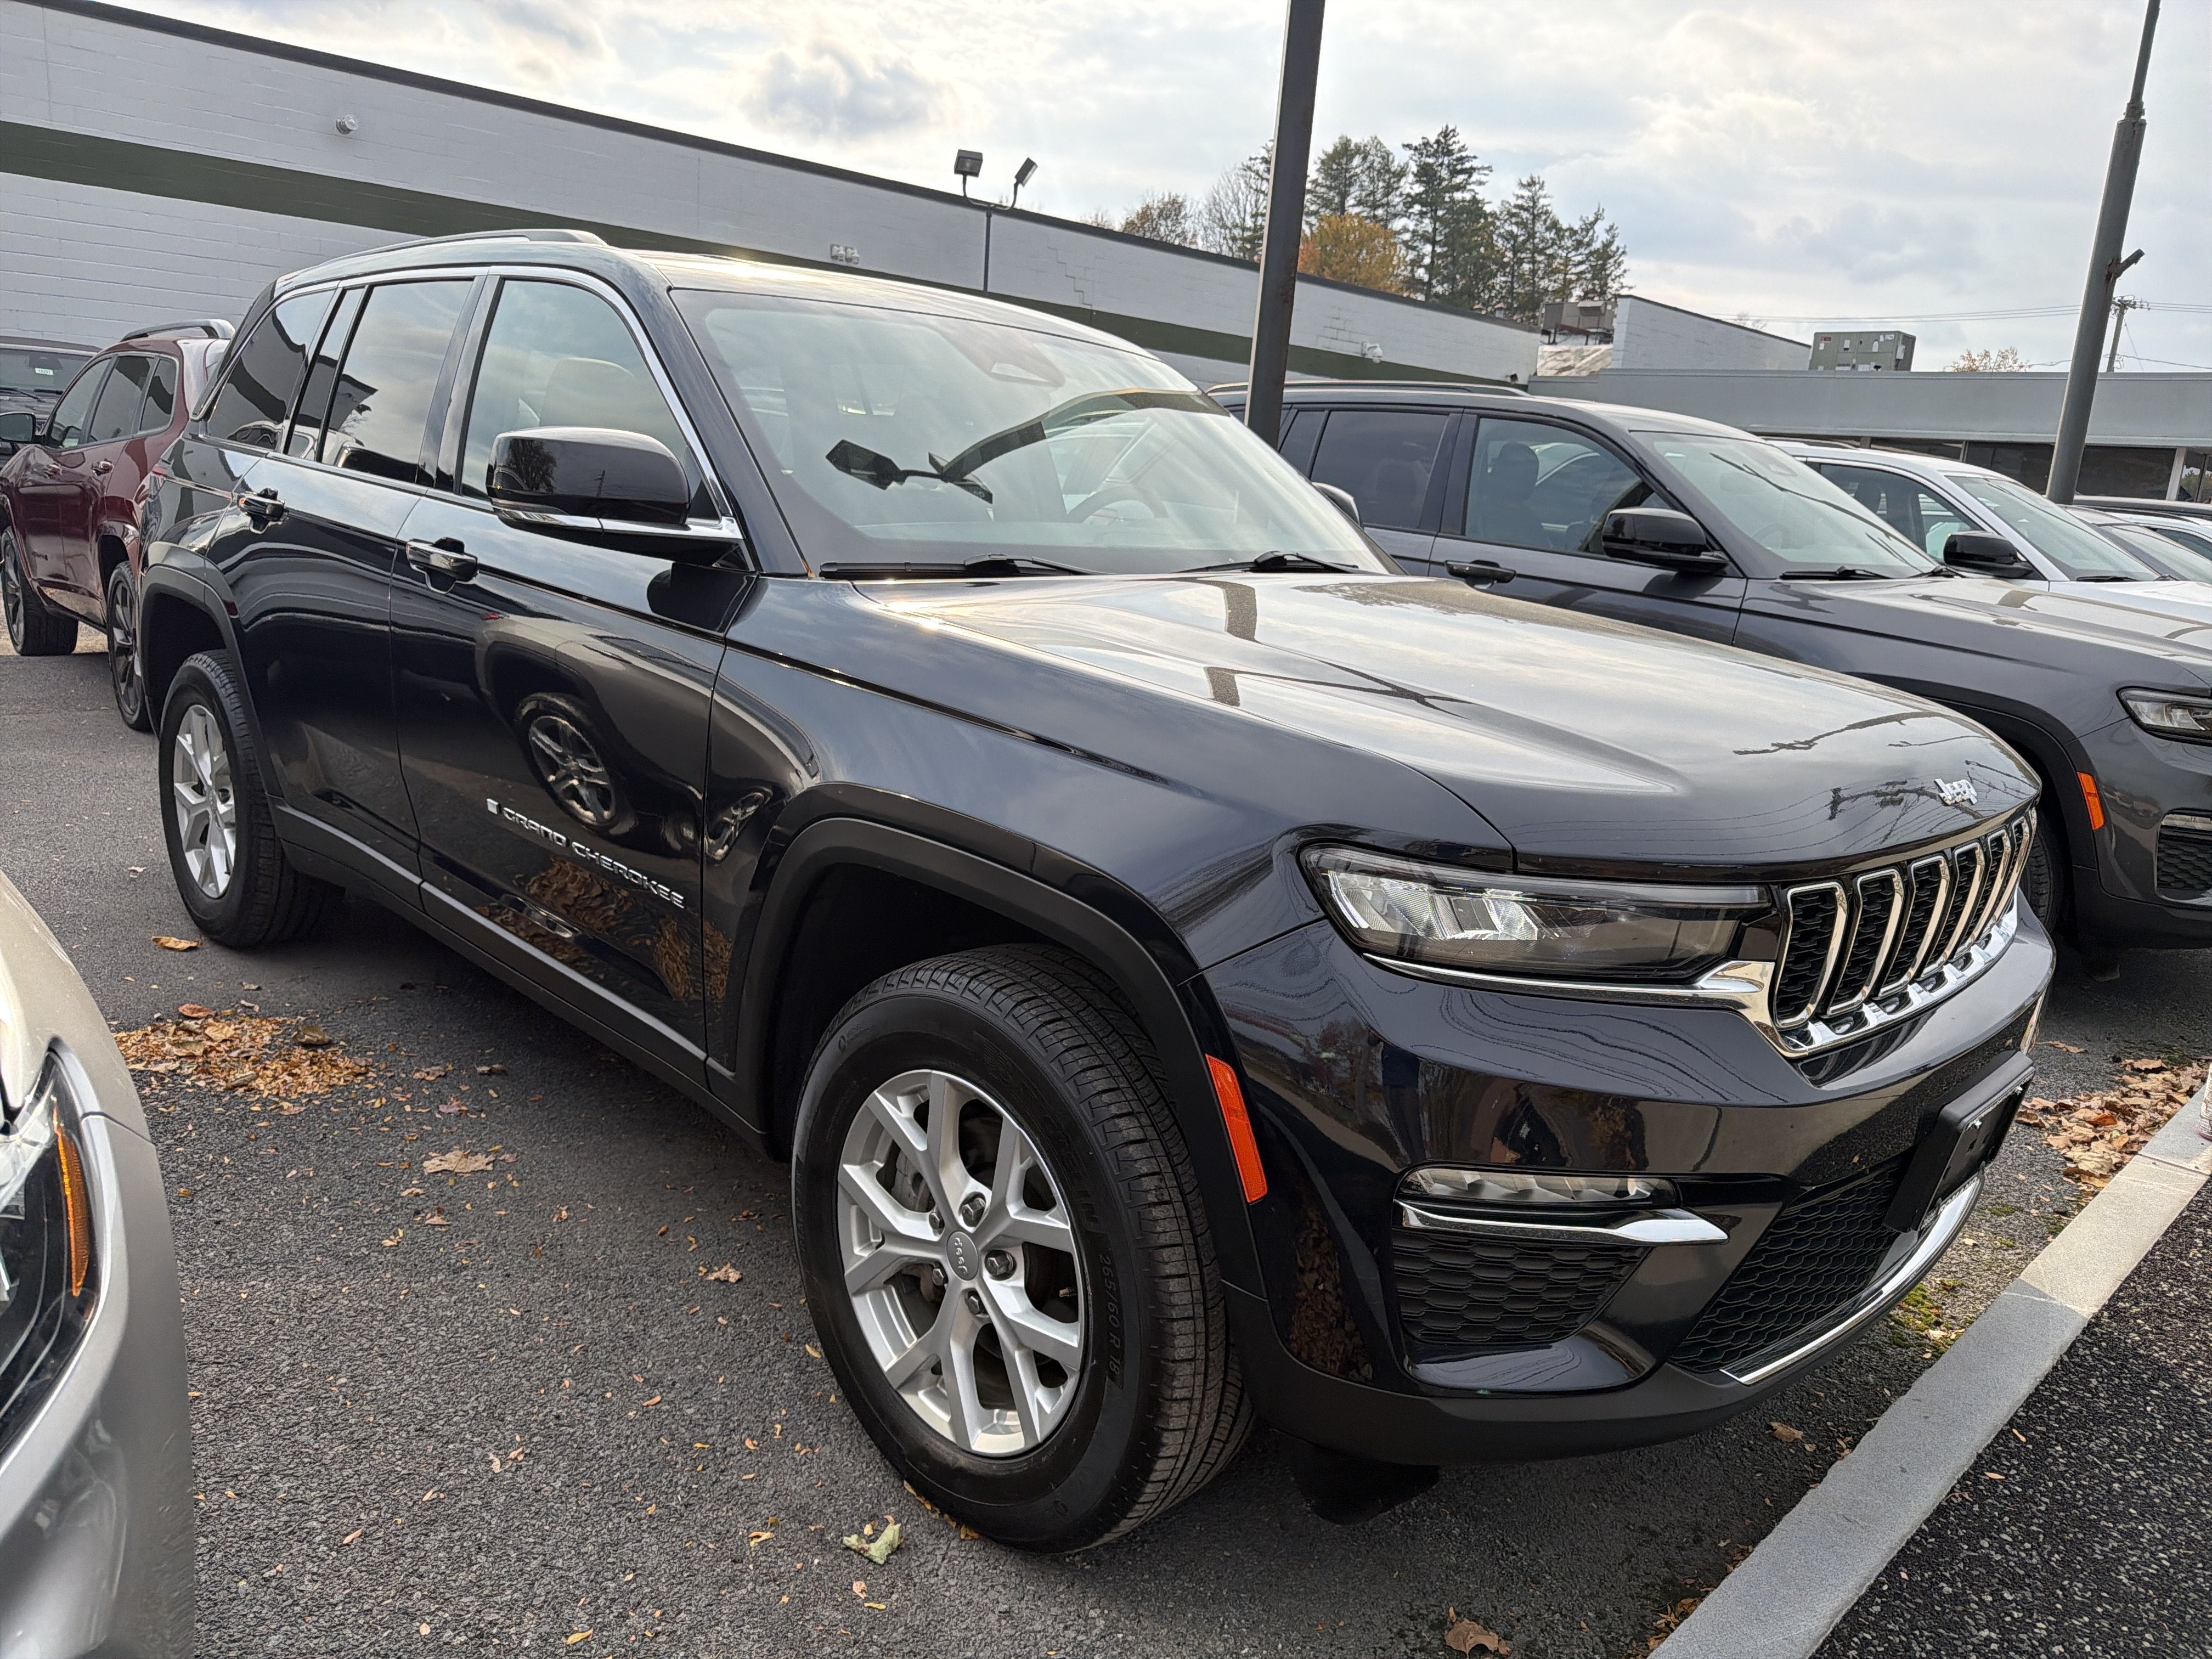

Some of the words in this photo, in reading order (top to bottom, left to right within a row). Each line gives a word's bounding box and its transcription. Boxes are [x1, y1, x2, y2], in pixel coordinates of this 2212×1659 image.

[1934, 778, 1977, 805] Jeep
[503, 807, 567, 848] GRAND
[572, 842, 685, 909] CHEROKEE
[954, 1237, 968, 1274] Jeep
